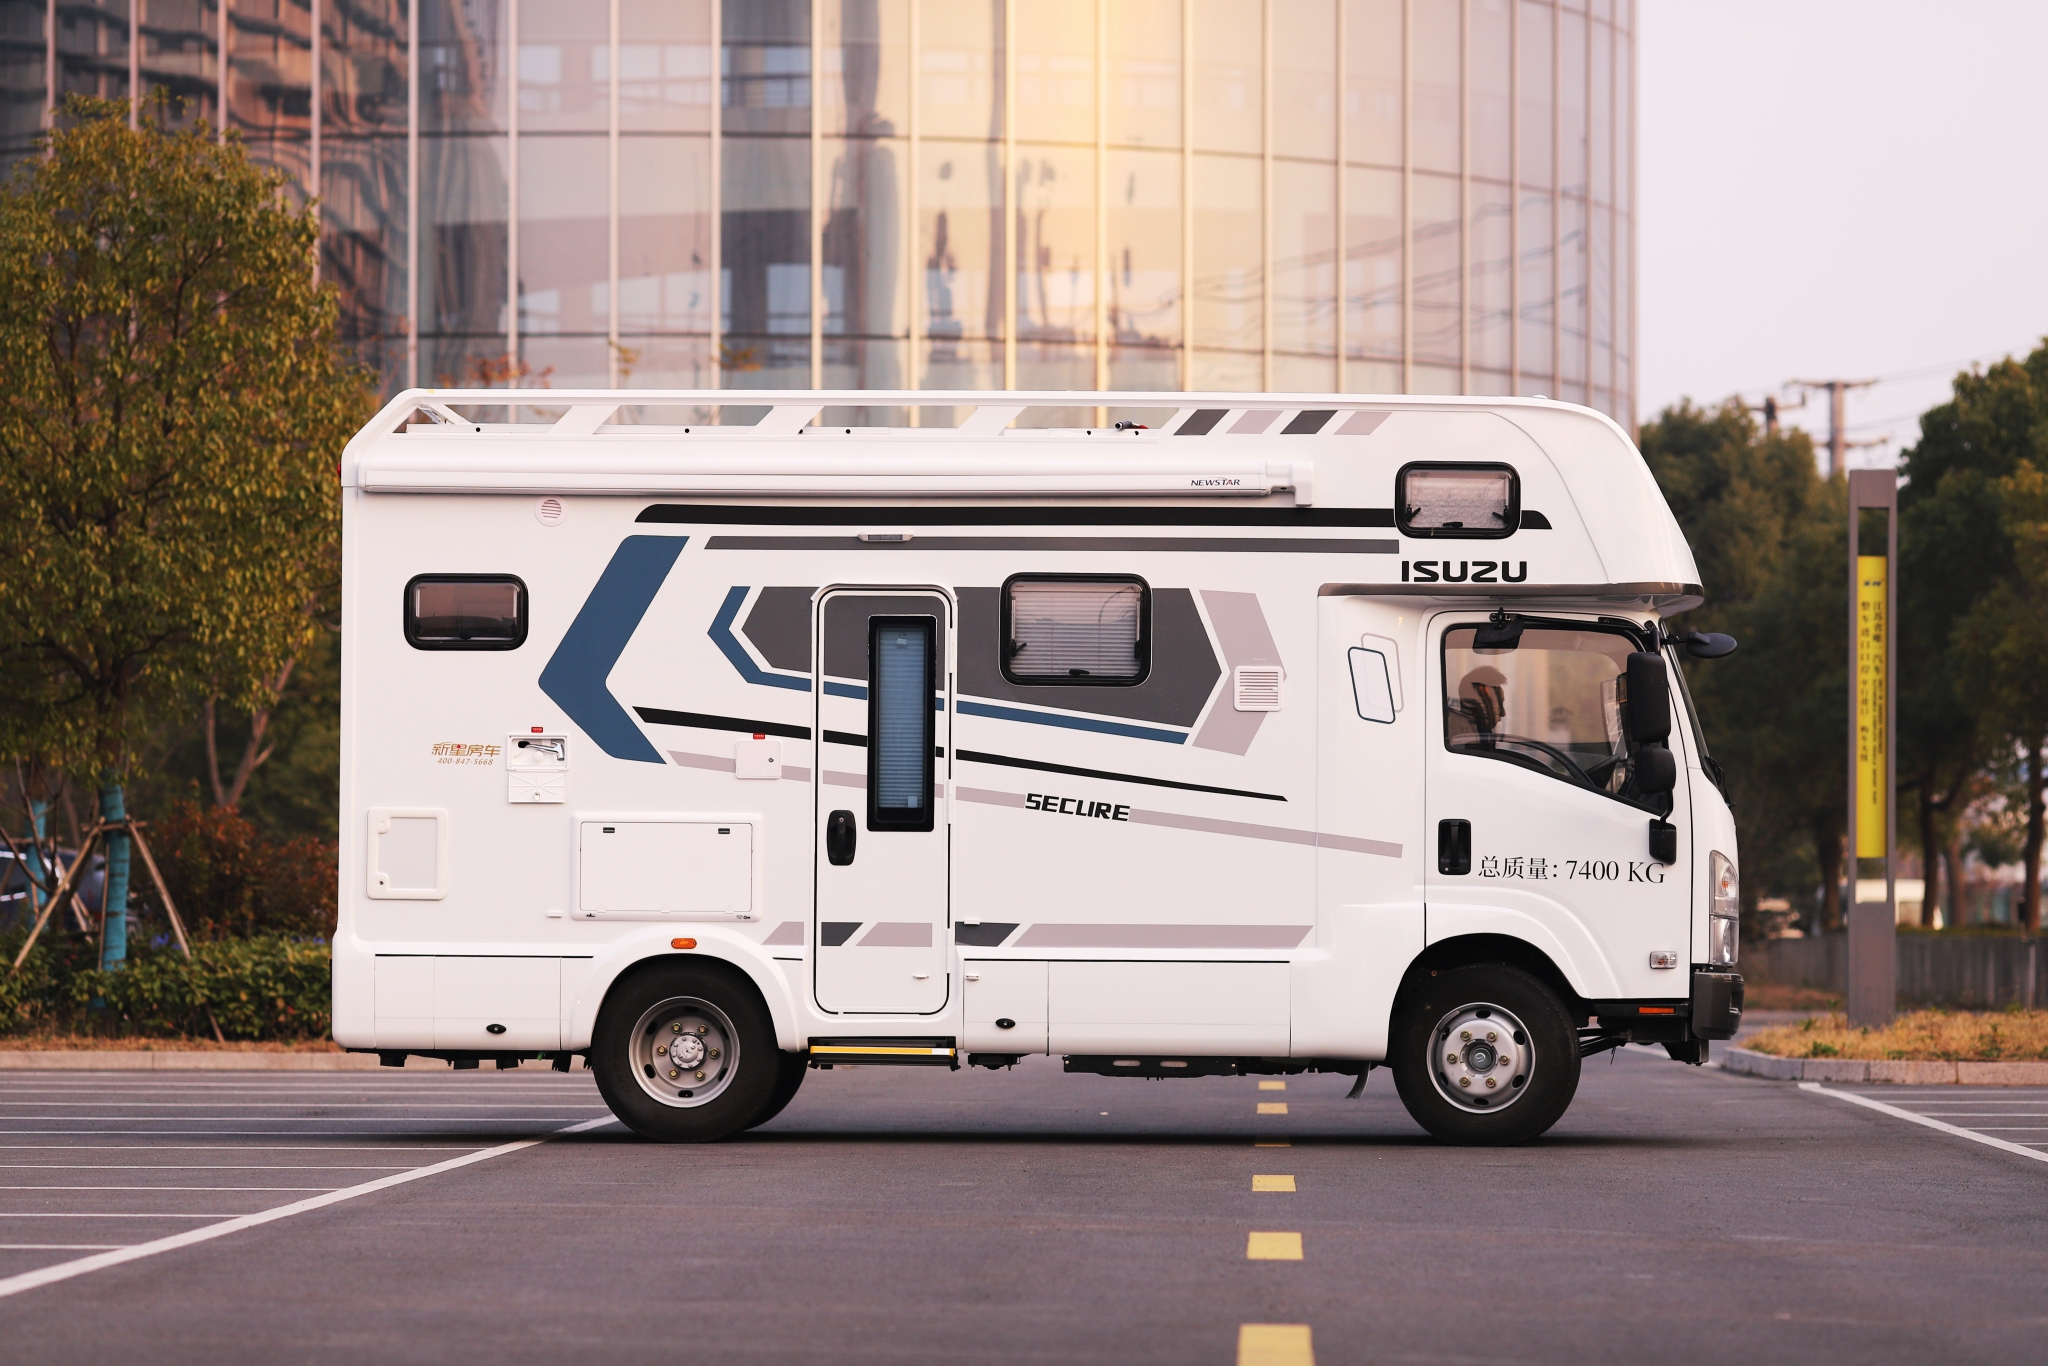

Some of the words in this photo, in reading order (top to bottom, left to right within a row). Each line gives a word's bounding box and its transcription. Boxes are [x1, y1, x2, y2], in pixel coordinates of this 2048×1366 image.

[1190, 479, 1241, 487] NEWSTAR
[1401, 560, 1527, 583] ISUZU
[431, 742, 502, 757] 新星房车
[437, 757, 494, 766] 400-847-5668
[1025, 792, 1131, 822] SECURE
[1565, 860, 1620, 881] 7400
[1627, 861, 1666, 884] KG
